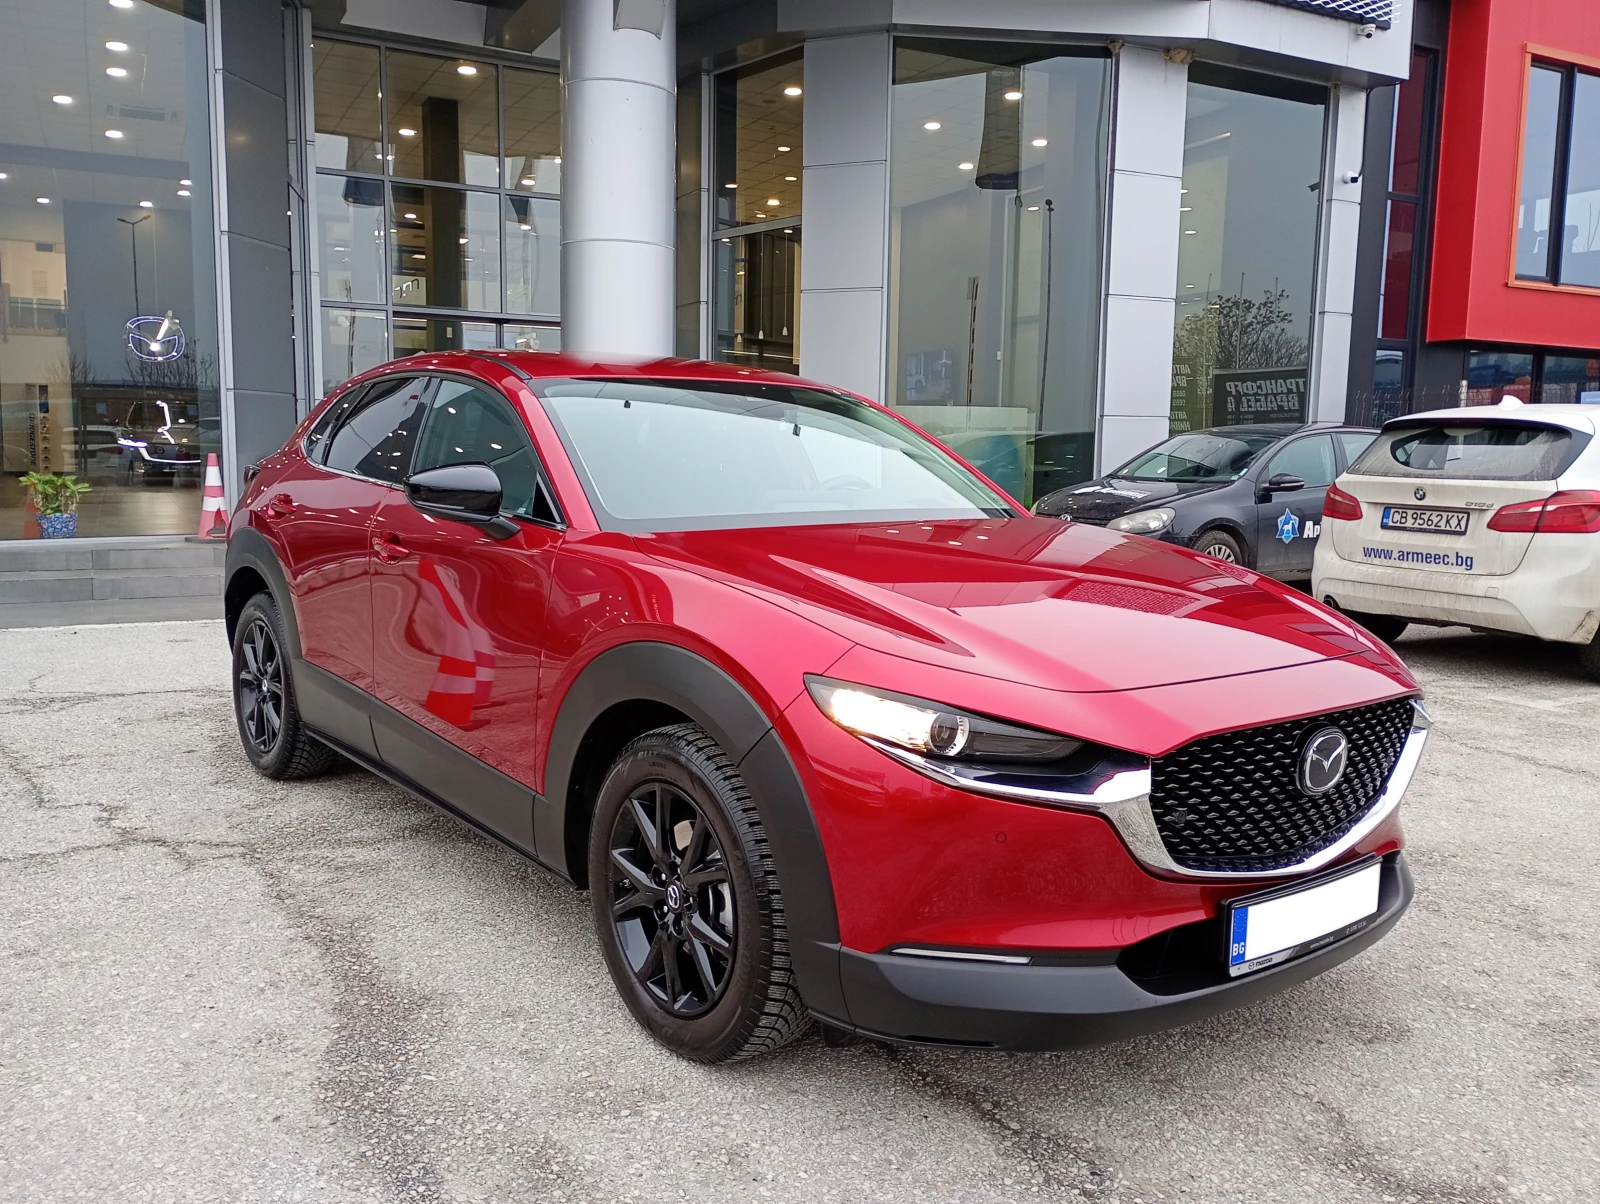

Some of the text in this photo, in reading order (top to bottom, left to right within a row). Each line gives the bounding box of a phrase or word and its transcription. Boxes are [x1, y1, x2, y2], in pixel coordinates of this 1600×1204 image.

[1391, 510, 1408, 525] CB
[1411, 512, 1443, 528] 9562
[1444, 514, 1465, 530] KX
[1363, 546, 1474, 571] www.armeec.bg
[1233, 942, 1246, 956] BG
[1255, 957, 1273, 967] mazda
